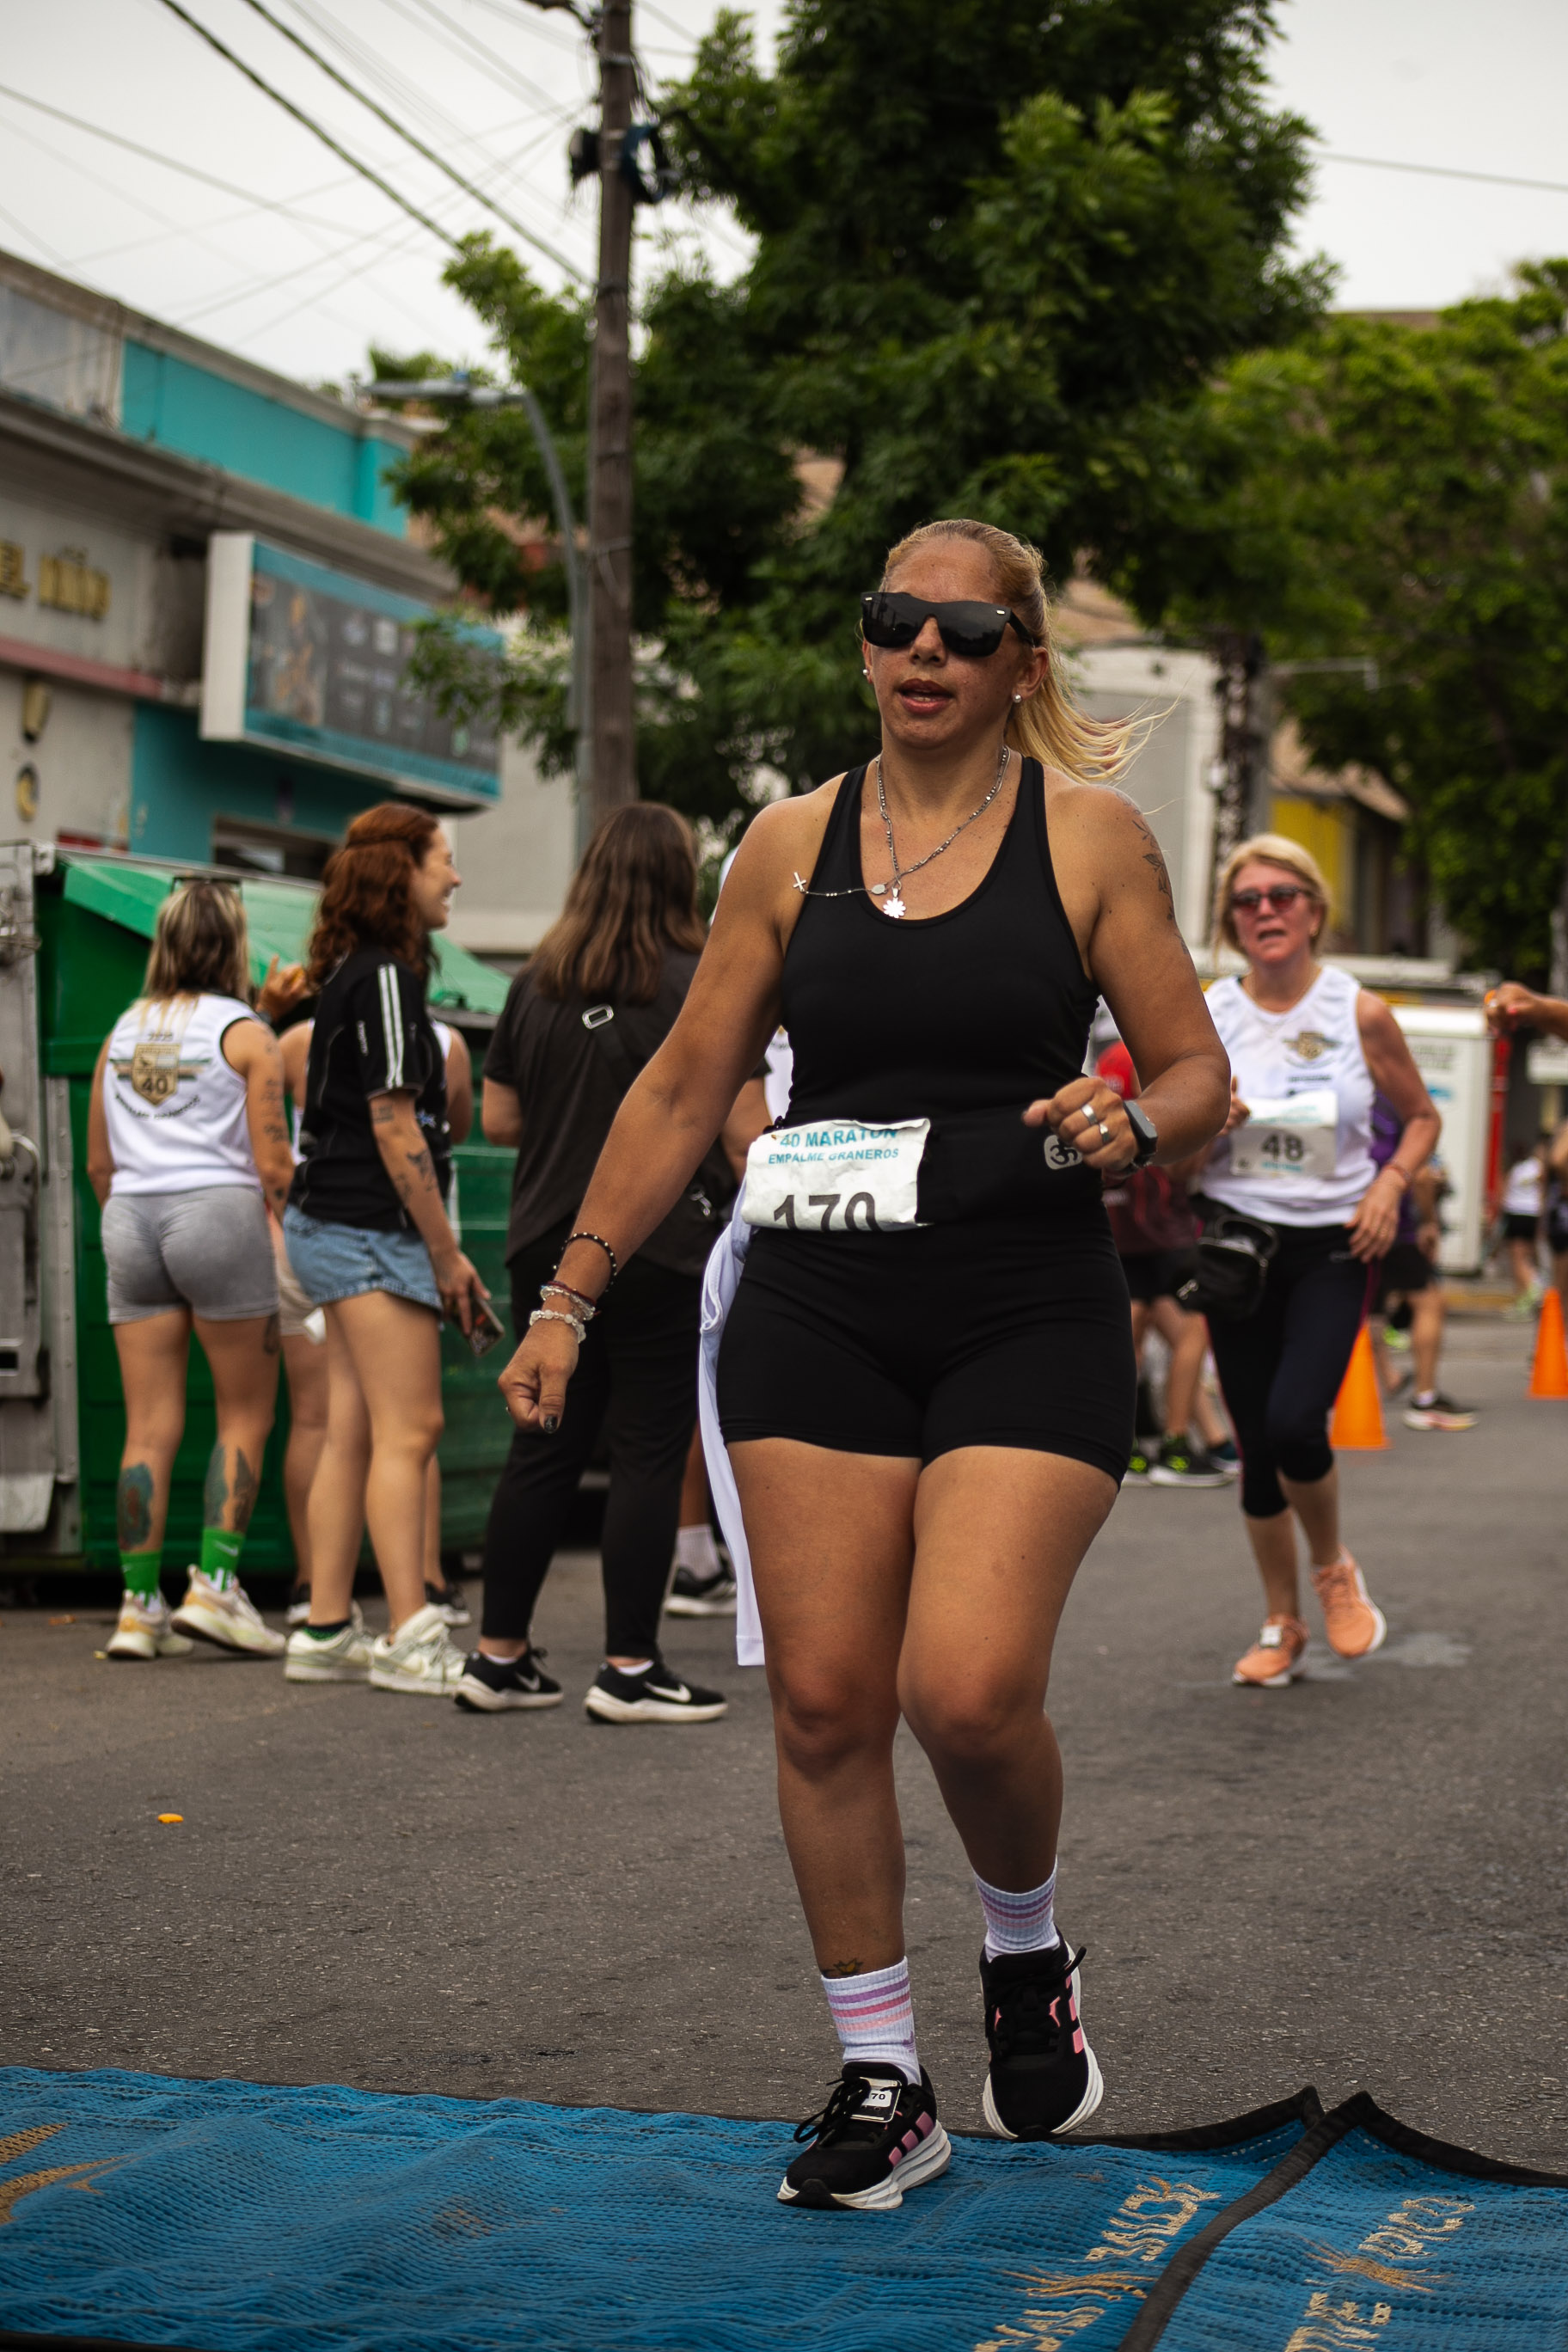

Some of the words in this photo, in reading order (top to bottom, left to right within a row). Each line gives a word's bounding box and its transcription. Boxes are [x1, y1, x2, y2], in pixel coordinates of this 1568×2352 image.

[141, 1076, 169, 1095] 40
[779, 1133, 800, 1148] 40
[1261, 1134, 1305, 1161] 48
[768, 1152, 824, 1165] EMPALME
[828, 1148, 899, 1161] GRANEROS
[774, 1191, 882, 1232] 170
